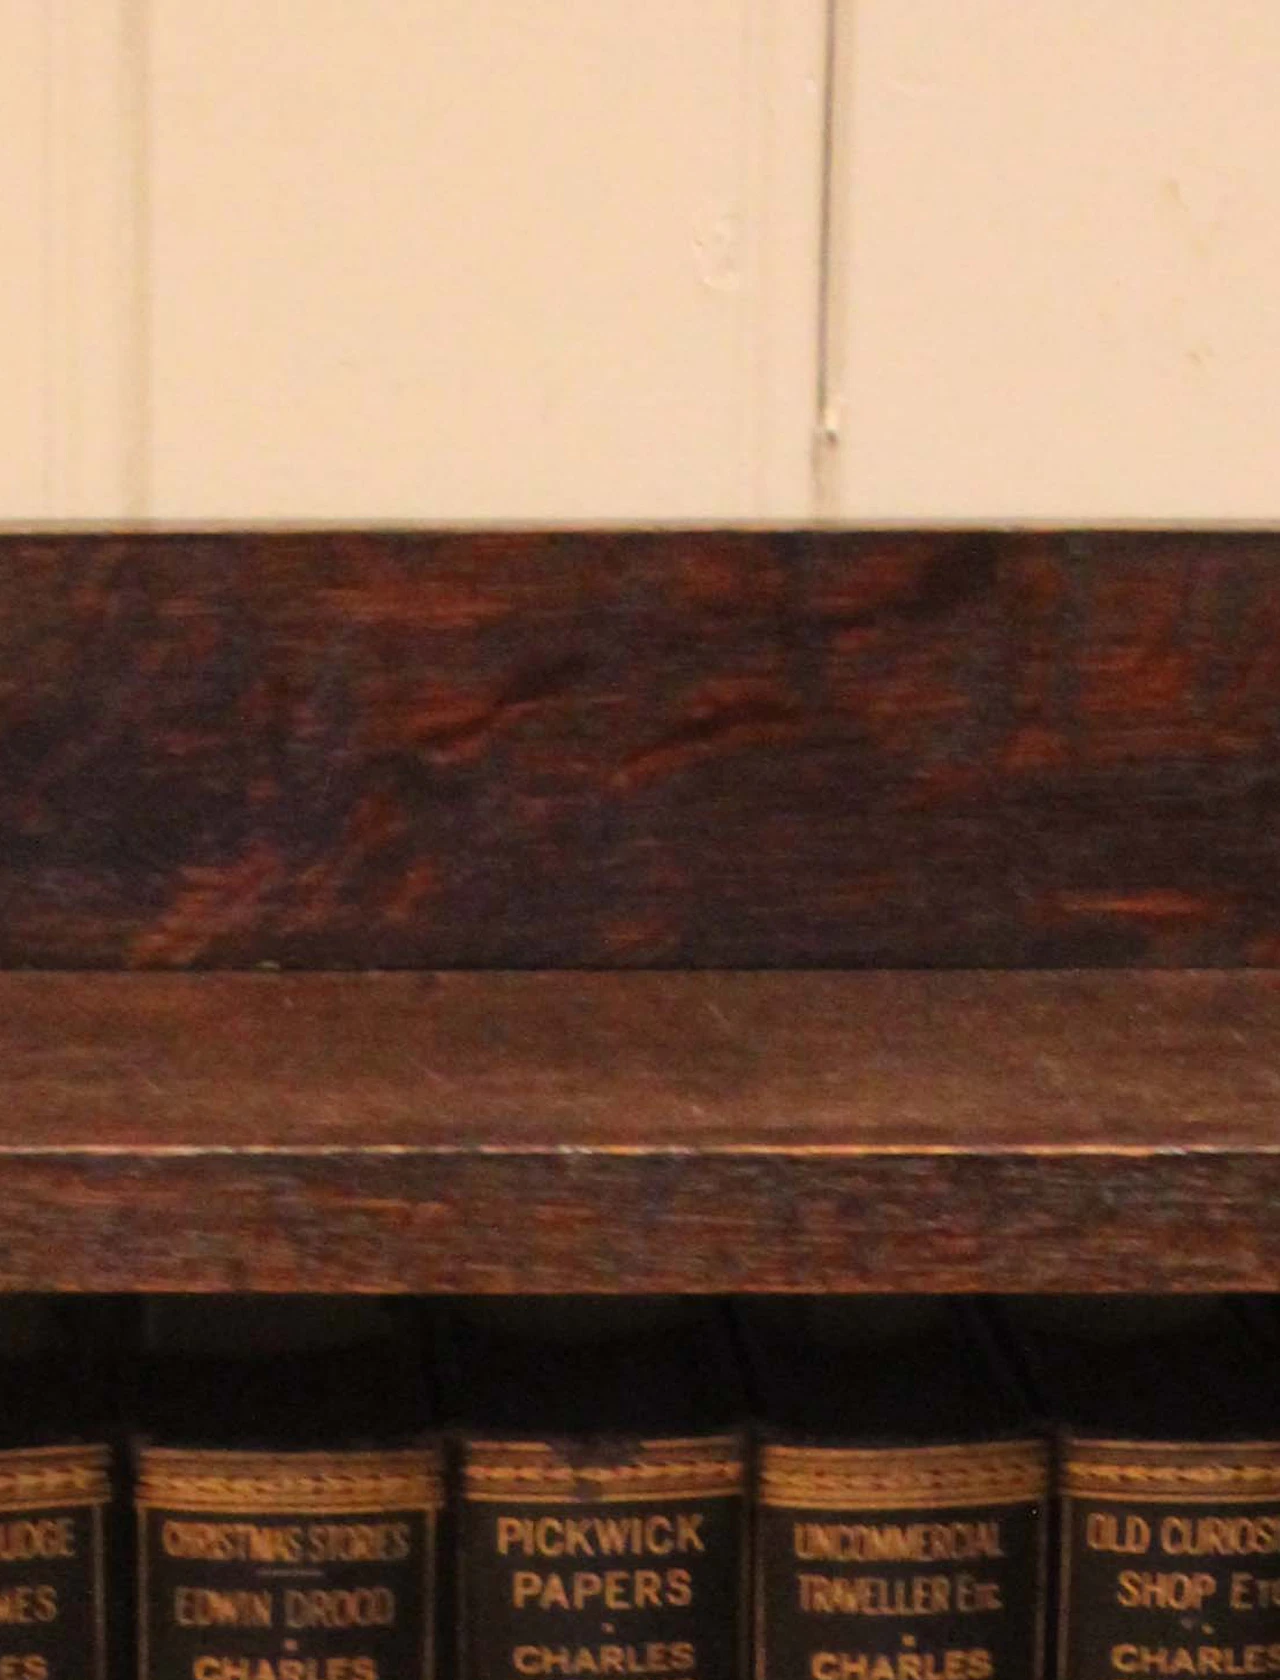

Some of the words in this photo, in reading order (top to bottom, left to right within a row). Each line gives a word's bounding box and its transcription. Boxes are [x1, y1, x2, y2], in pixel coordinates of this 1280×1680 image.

[161, 1520, 301, 1562] CHRISTMAS
[309, 1521, 410, 1562] STORIES
[496, 1514, 705, 1556] PICKWICK
[793, 1521, 1006, 1561] UNCOMMERCIAL
[1086, 1513, 1150, 1555] OLD
[175, 1588, 272, 1628] EDWIN
[285, 1587, 395, 1628] DROOD
[512, 1569, 693, 1610] PAPERS
[799, 1573, 950, 1615] TRAVELLER
[1117, 1570, 1217, 1611] SHOP
[512, 1641, 695, 1675] CHARLES
